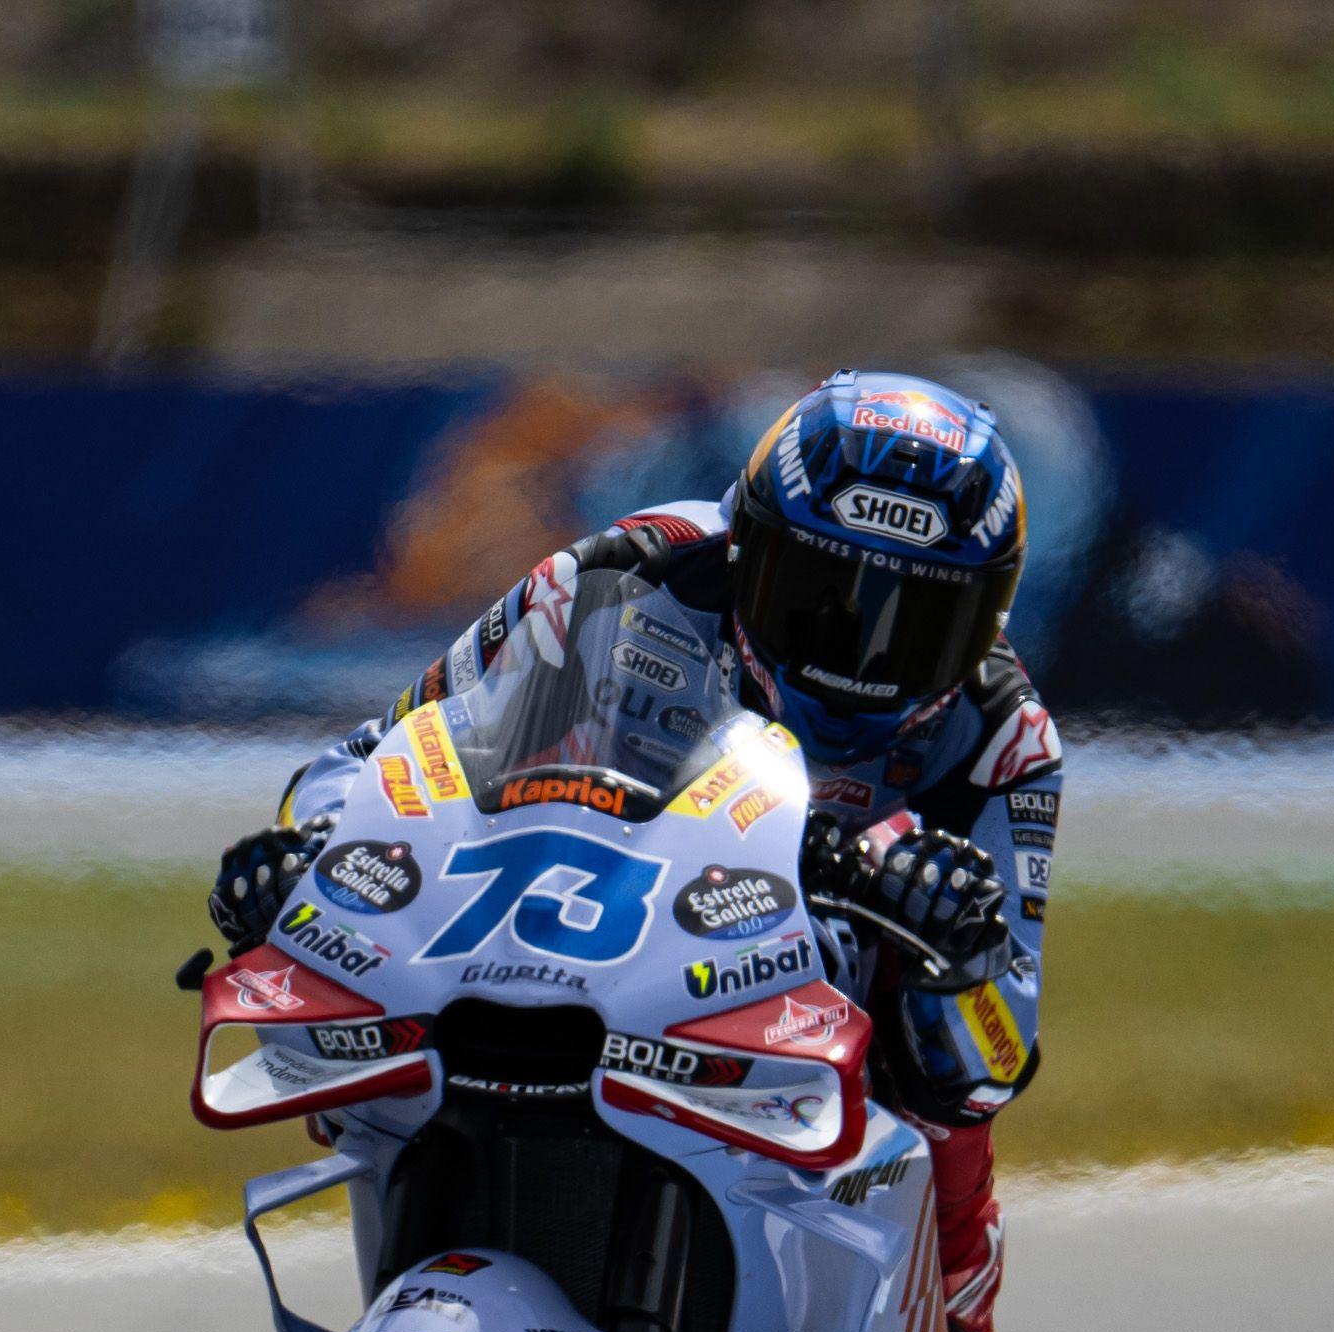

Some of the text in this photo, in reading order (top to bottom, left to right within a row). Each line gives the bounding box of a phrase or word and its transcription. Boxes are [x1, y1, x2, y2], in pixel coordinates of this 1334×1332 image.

[853, 407, 965, 453] Red Bull
[849, 493, 933, 537] SHOEI
[861, 550, 902, 571] YOU
[912, 562, 974, 583] WINGS
[618, 648, 680, 688] SHOEI
[801, 665, 899, 697] UNBRAKED
[412, 709, 460, 798] Antangin
[500, 776, 625, 816] Kapriol
[1009, 793, 1056, 812] BOLD
[331, 861, 391, 906] Galicia
[344, 846, 410, 892] Estrella
[409, 826, 671, 967] 73
[688, 878, 772, 913] Estrella
[701, 894, 779, 928] Galicia
[278, 901, 384, 977] Unibat
[460, 960, 587, 992] Gigetta
[683, 935, 813, 999] Unibat
[317, 1026, 382, 1049] BOLD
[769, 1009, 844, 1039] FEDERAL OIL
[603, 1033, 699, 1075] BOLD
